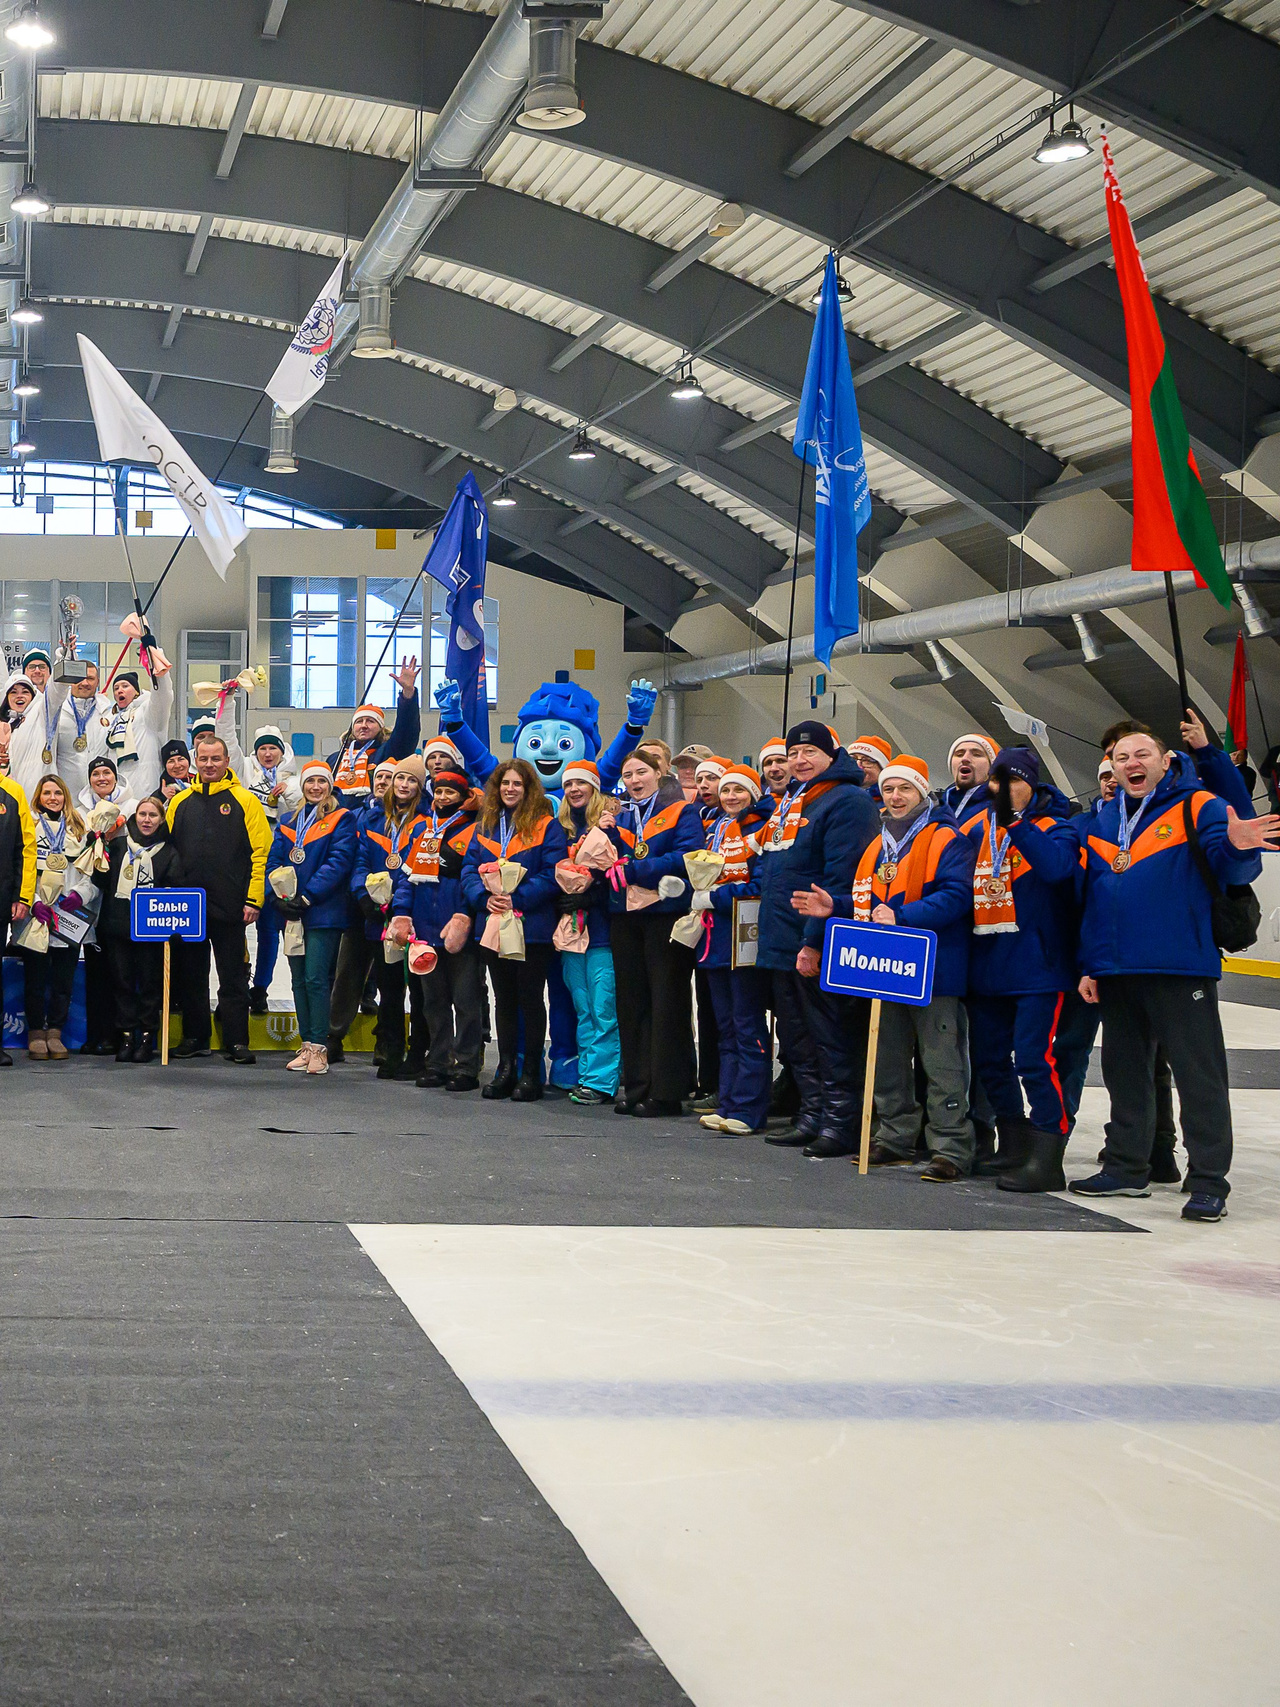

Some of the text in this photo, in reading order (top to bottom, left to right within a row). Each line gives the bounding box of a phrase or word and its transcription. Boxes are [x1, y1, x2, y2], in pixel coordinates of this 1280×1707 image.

[144, 438, 208, 508] ОСТЬ
[149, 898, 188, 912] Белые
[146, 916, 190, 931] тигры
[839, 946, 917, 978] Молния
